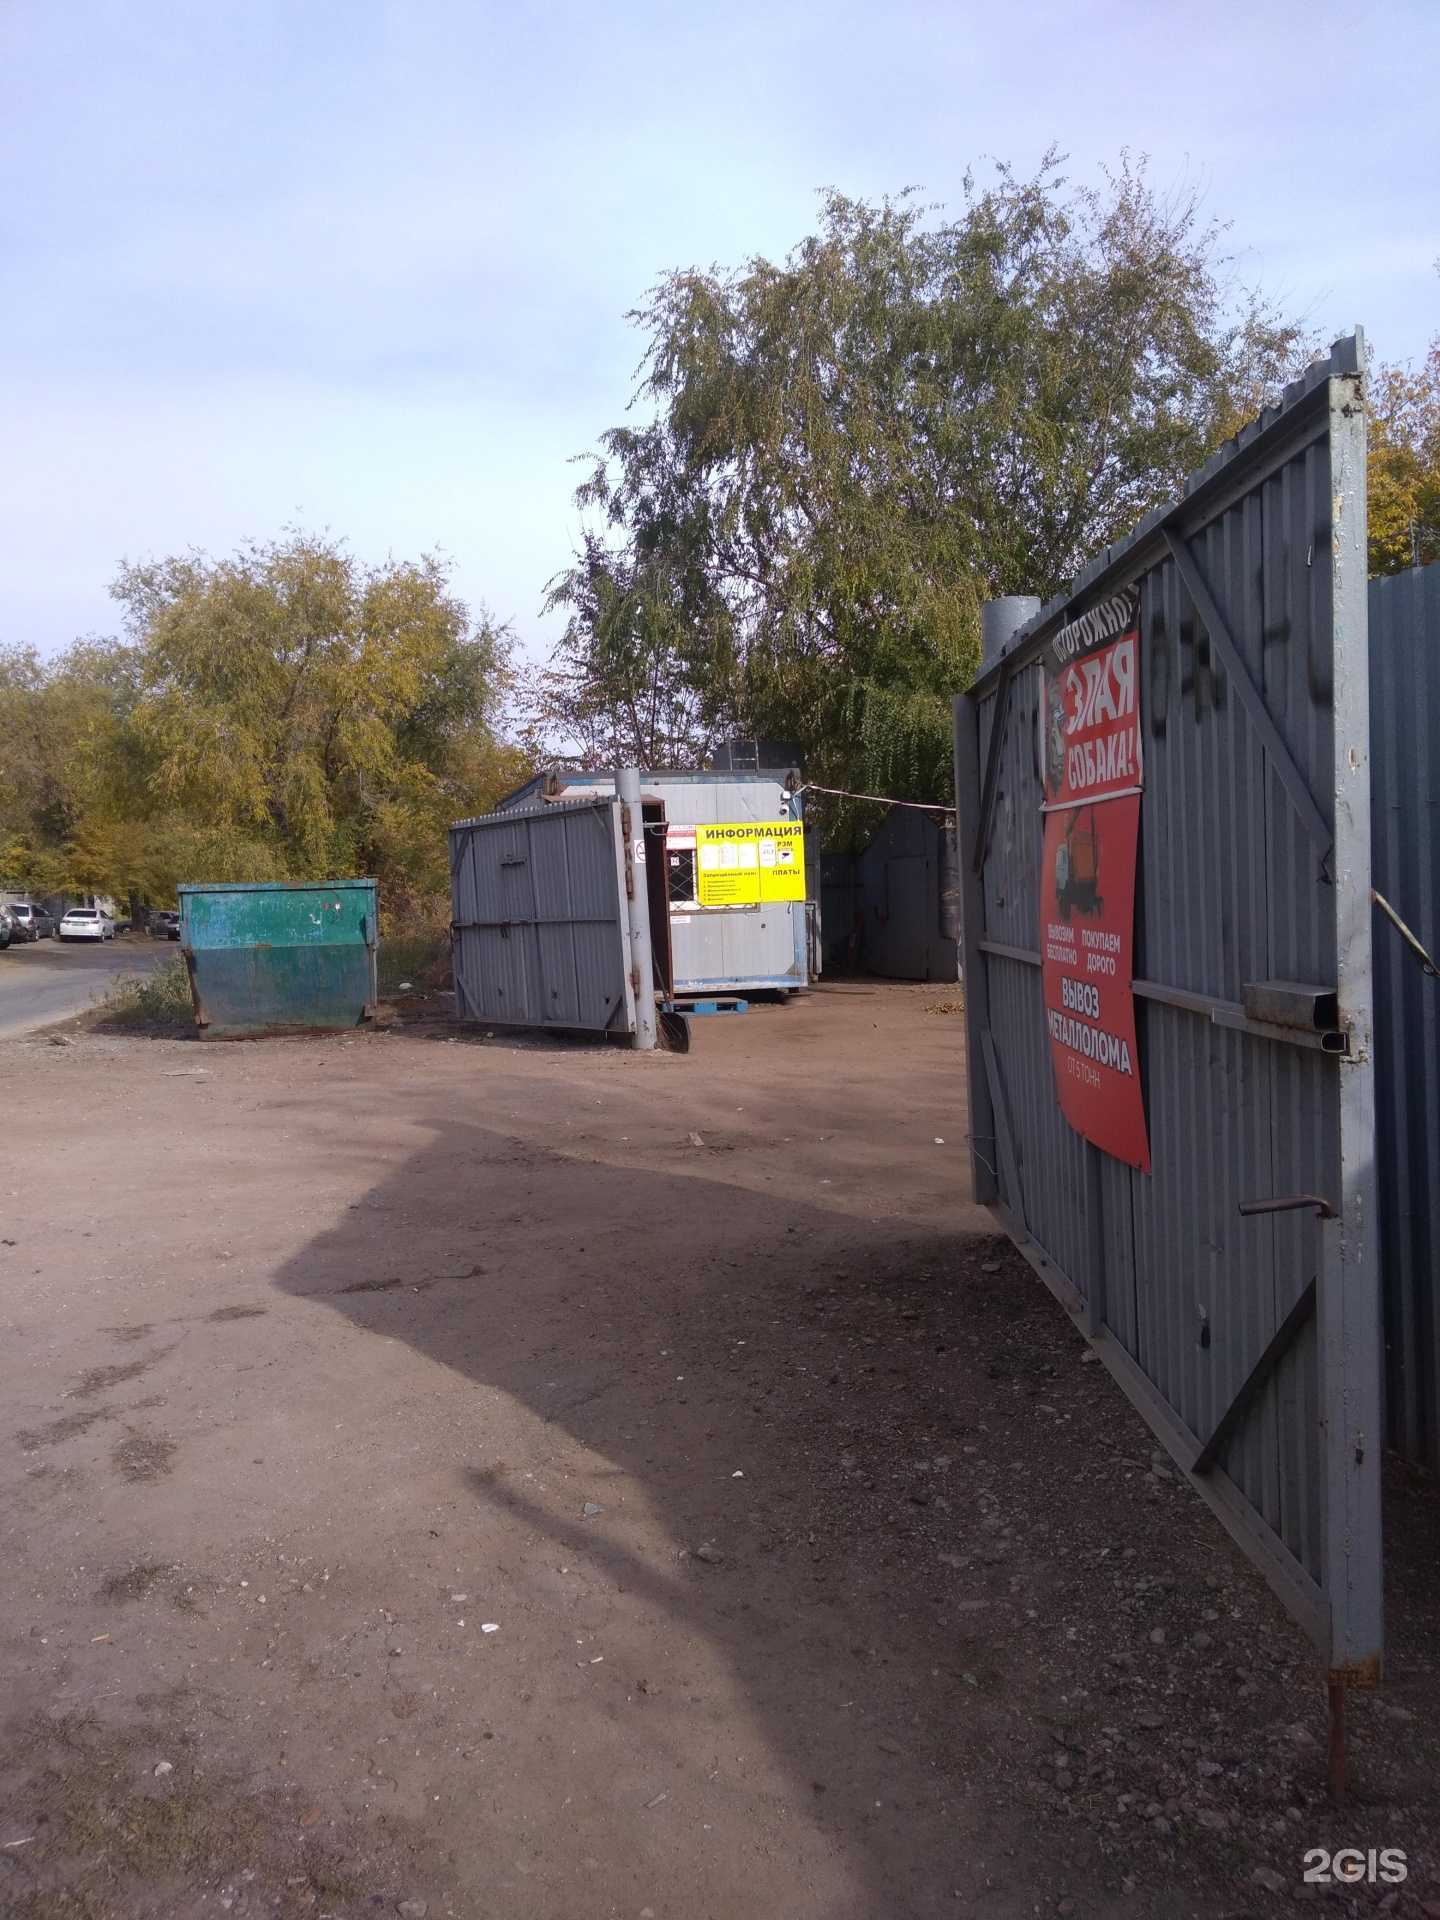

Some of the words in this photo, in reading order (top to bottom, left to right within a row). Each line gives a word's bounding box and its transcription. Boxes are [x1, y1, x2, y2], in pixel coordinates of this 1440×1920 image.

[1053, 593, 1132, 662] ОСТОРОЖНО!
[1066, 640, 1133, 735] ЗЛАЯ
[1068, 727, 1133, 789] СОБАКА!
[706, 826, 801, 839] ИНФОРМАЦИЯ
[1048, 924, 1074, 943] ВЫВОЗИМ
[1082, 929, 1120, 953] ПОКУПАЕМ
[1047, 944, 1077, 965] БЕСПЛАТНО
[1087, 953, 1115, 976] ДОРОГО
[1062, 977, 1099, 1018] ВЫВОЗ
[1048, 1007, 1132, 1075] МЕТАЛЛОЛОМА
